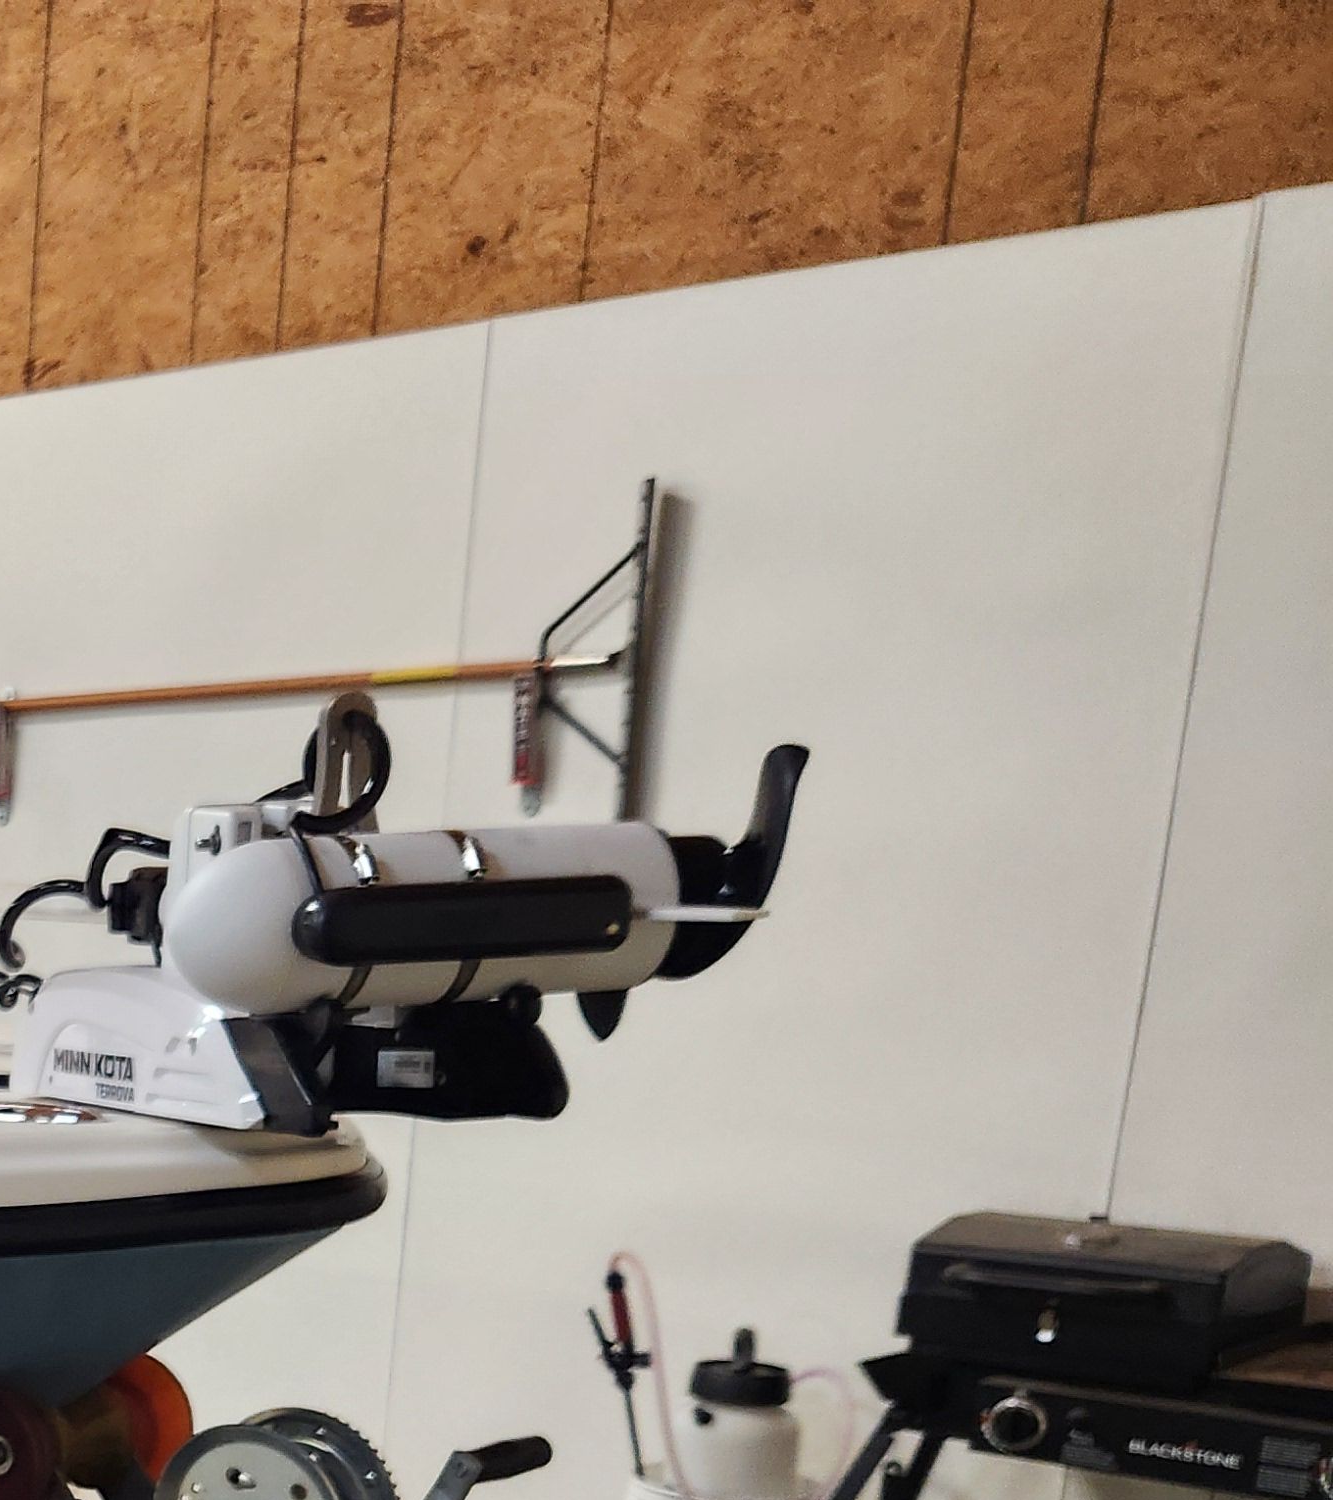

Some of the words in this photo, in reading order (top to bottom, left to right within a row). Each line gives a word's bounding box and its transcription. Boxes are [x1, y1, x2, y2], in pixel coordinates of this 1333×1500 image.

[53, 1048, 91, 1075] MINN
[94, 1053, 134, 1082] KOTA
[1129, 1437, 1242, 1470] BLACKSTONE
